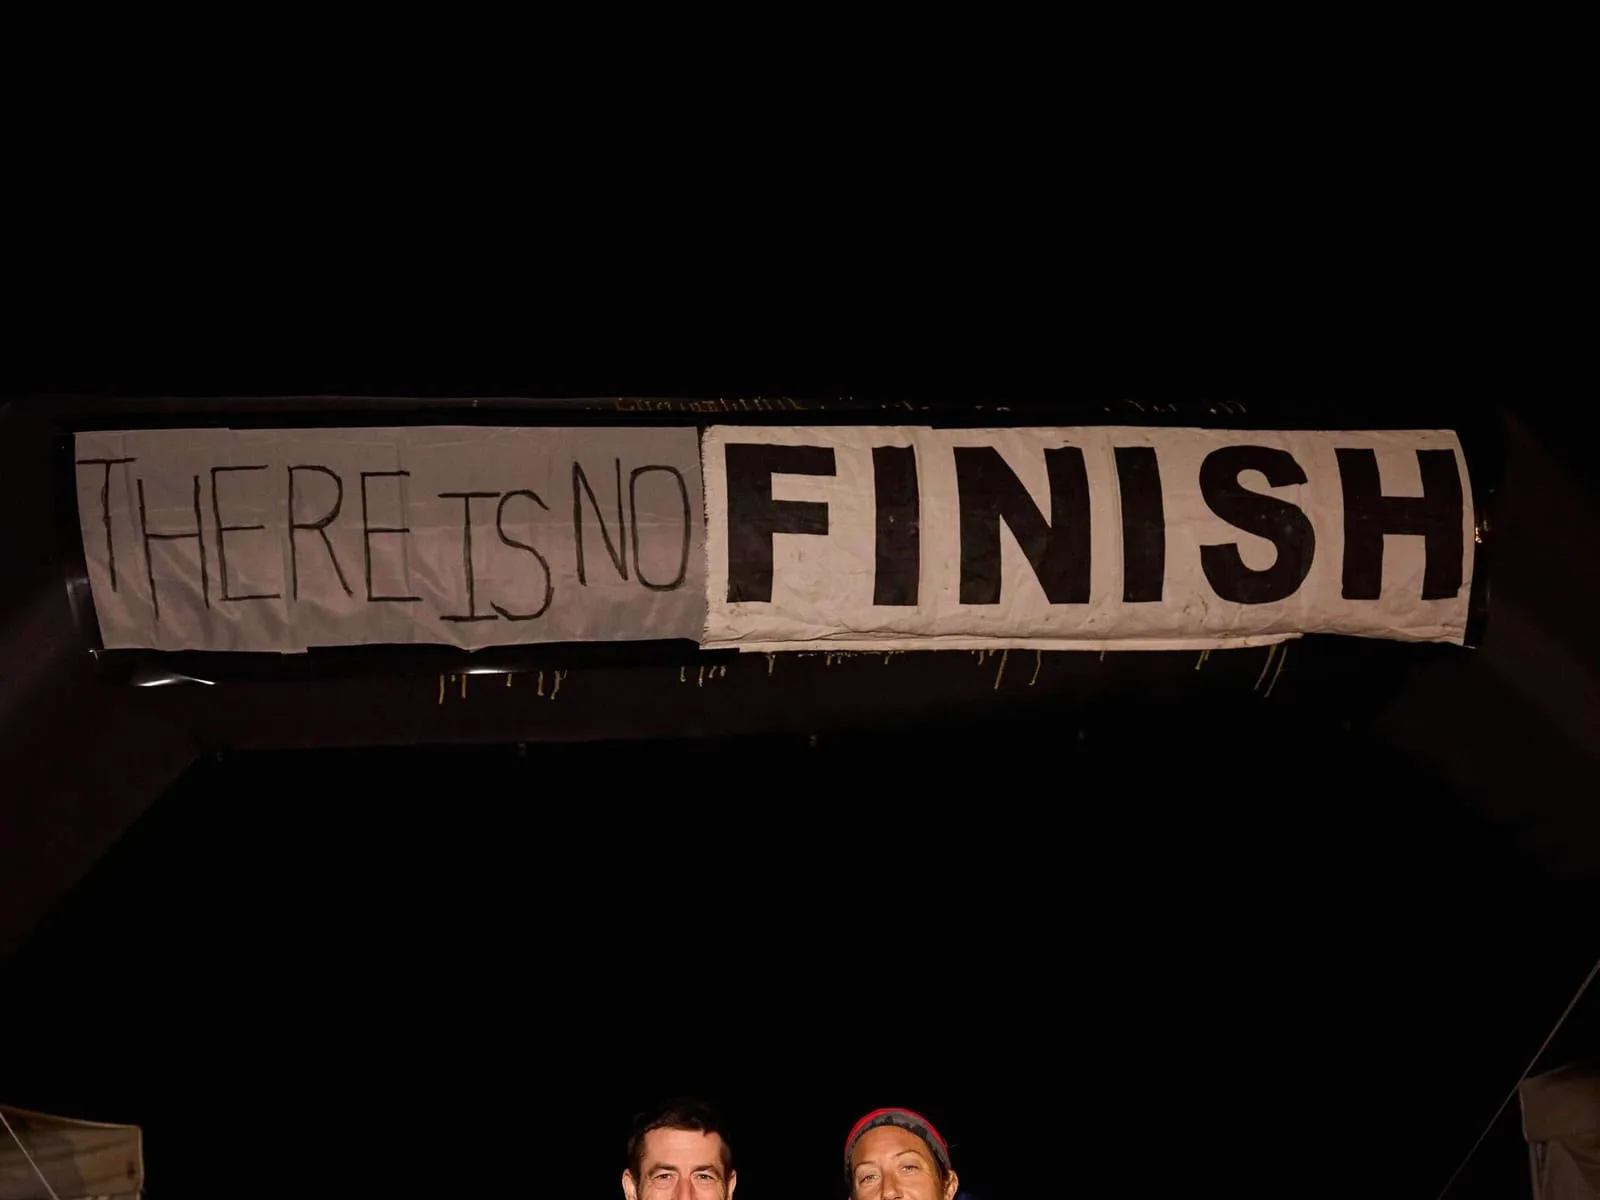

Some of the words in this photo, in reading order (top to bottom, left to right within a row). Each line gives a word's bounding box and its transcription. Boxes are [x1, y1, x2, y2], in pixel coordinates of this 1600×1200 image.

[77, 457, 422, 619] THERE
[437, 489, 553, 621] IS
[572, 458, 692, 592] NO
[724, 443, 1463, 605] FINISH
